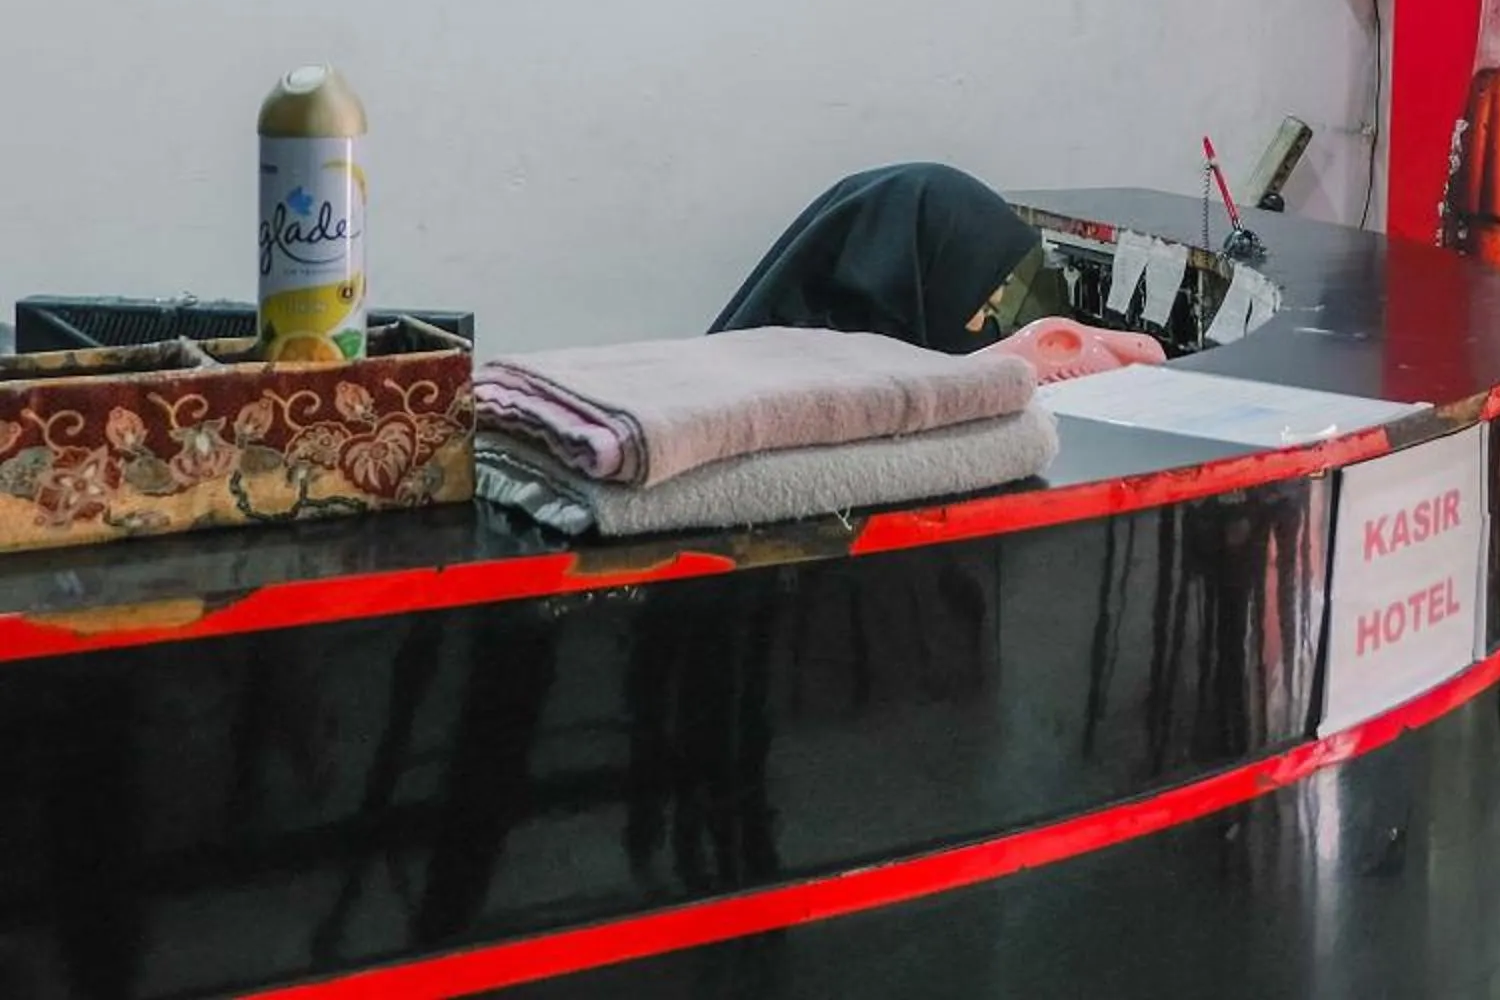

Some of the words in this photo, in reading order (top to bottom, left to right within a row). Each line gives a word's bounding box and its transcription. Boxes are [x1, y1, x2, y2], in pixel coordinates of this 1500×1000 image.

[258, 200, 362, 276] glade
[1362, 489, 1461, 562] KASIR
[1355, 577, 1461, 657] HOTEL
